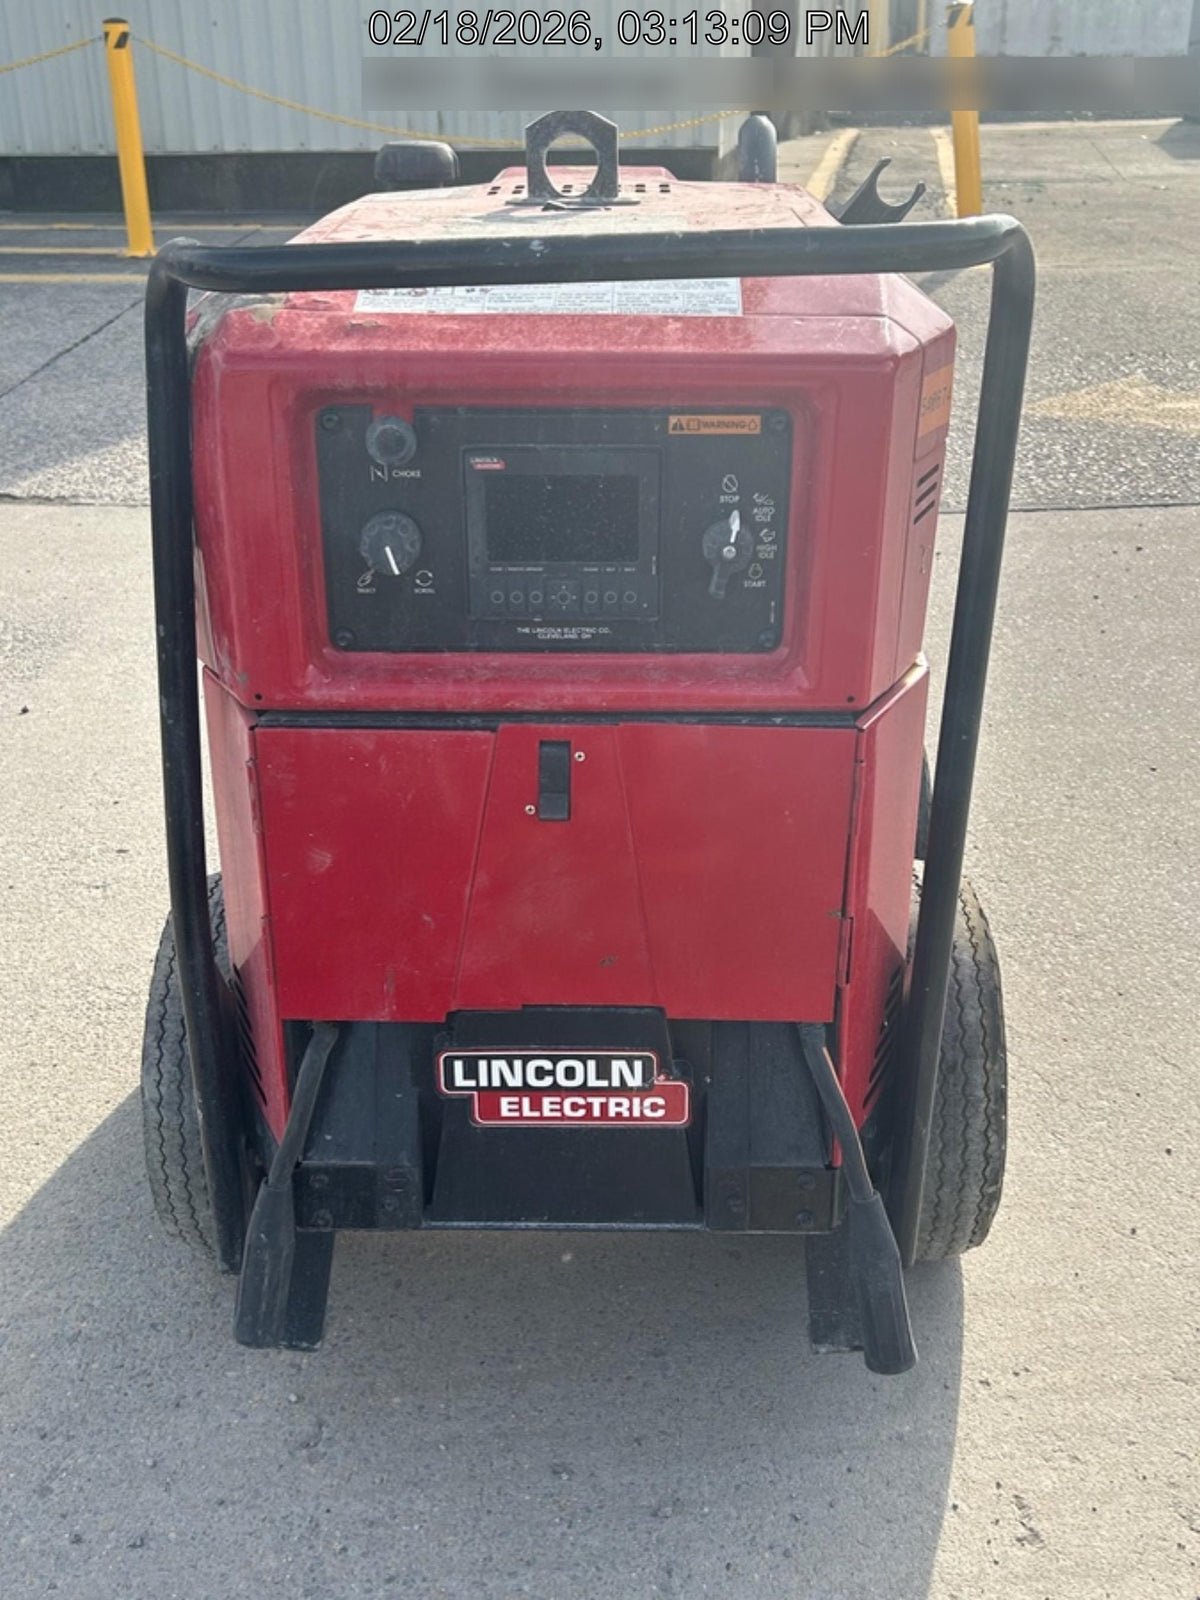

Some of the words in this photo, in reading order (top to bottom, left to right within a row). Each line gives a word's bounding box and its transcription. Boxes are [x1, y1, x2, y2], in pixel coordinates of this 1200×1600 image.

[701, 420, 748, 430] WARNING
[392, 469, 421, 479] CHOKE
[720, 495, 740, 504] STOP
[752, 507, 775, 515] AUTO
[743, 580, 766, 588] START
[516, 626, 530, 634] THE
[532, 626, 562, 634] LINCOLN
[563, 626, 597, 634] ELECTRIC
[453, 1059, 643, 1088] LINCOLN
[499, 1096, 667, 1118] ELECTRIC
